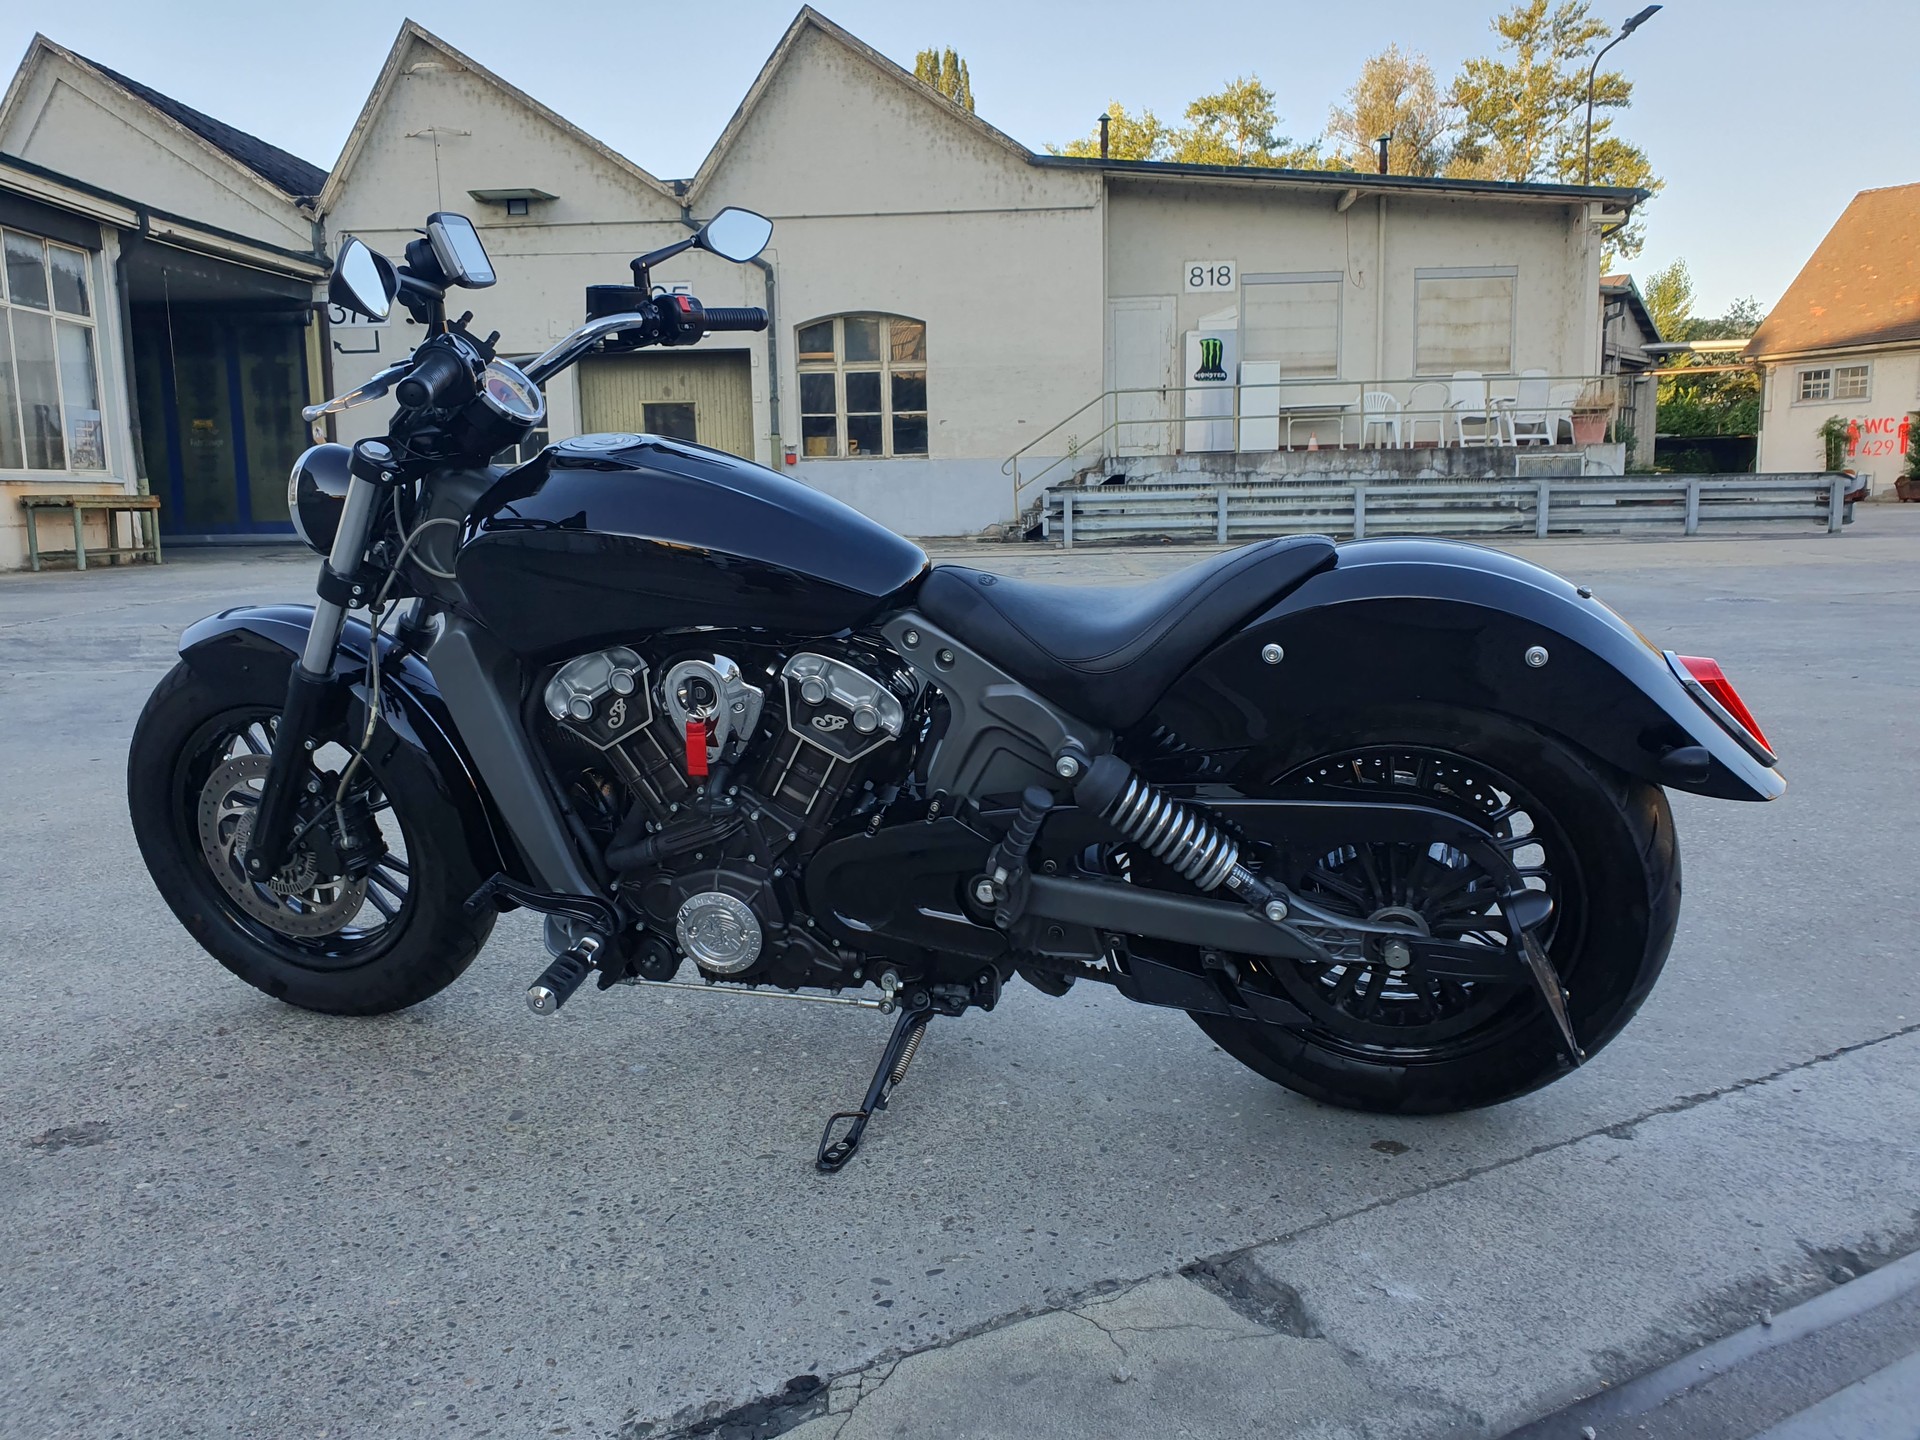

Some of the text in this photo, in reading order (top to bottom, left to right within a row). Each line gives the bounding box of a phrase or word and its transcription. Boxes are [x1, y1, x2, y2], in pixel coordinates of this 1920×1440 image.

[1190, 266, 1231, 287] 818
[1864, 417, 1895, 434] WC
[1862, 440, 1894, 456] 429
